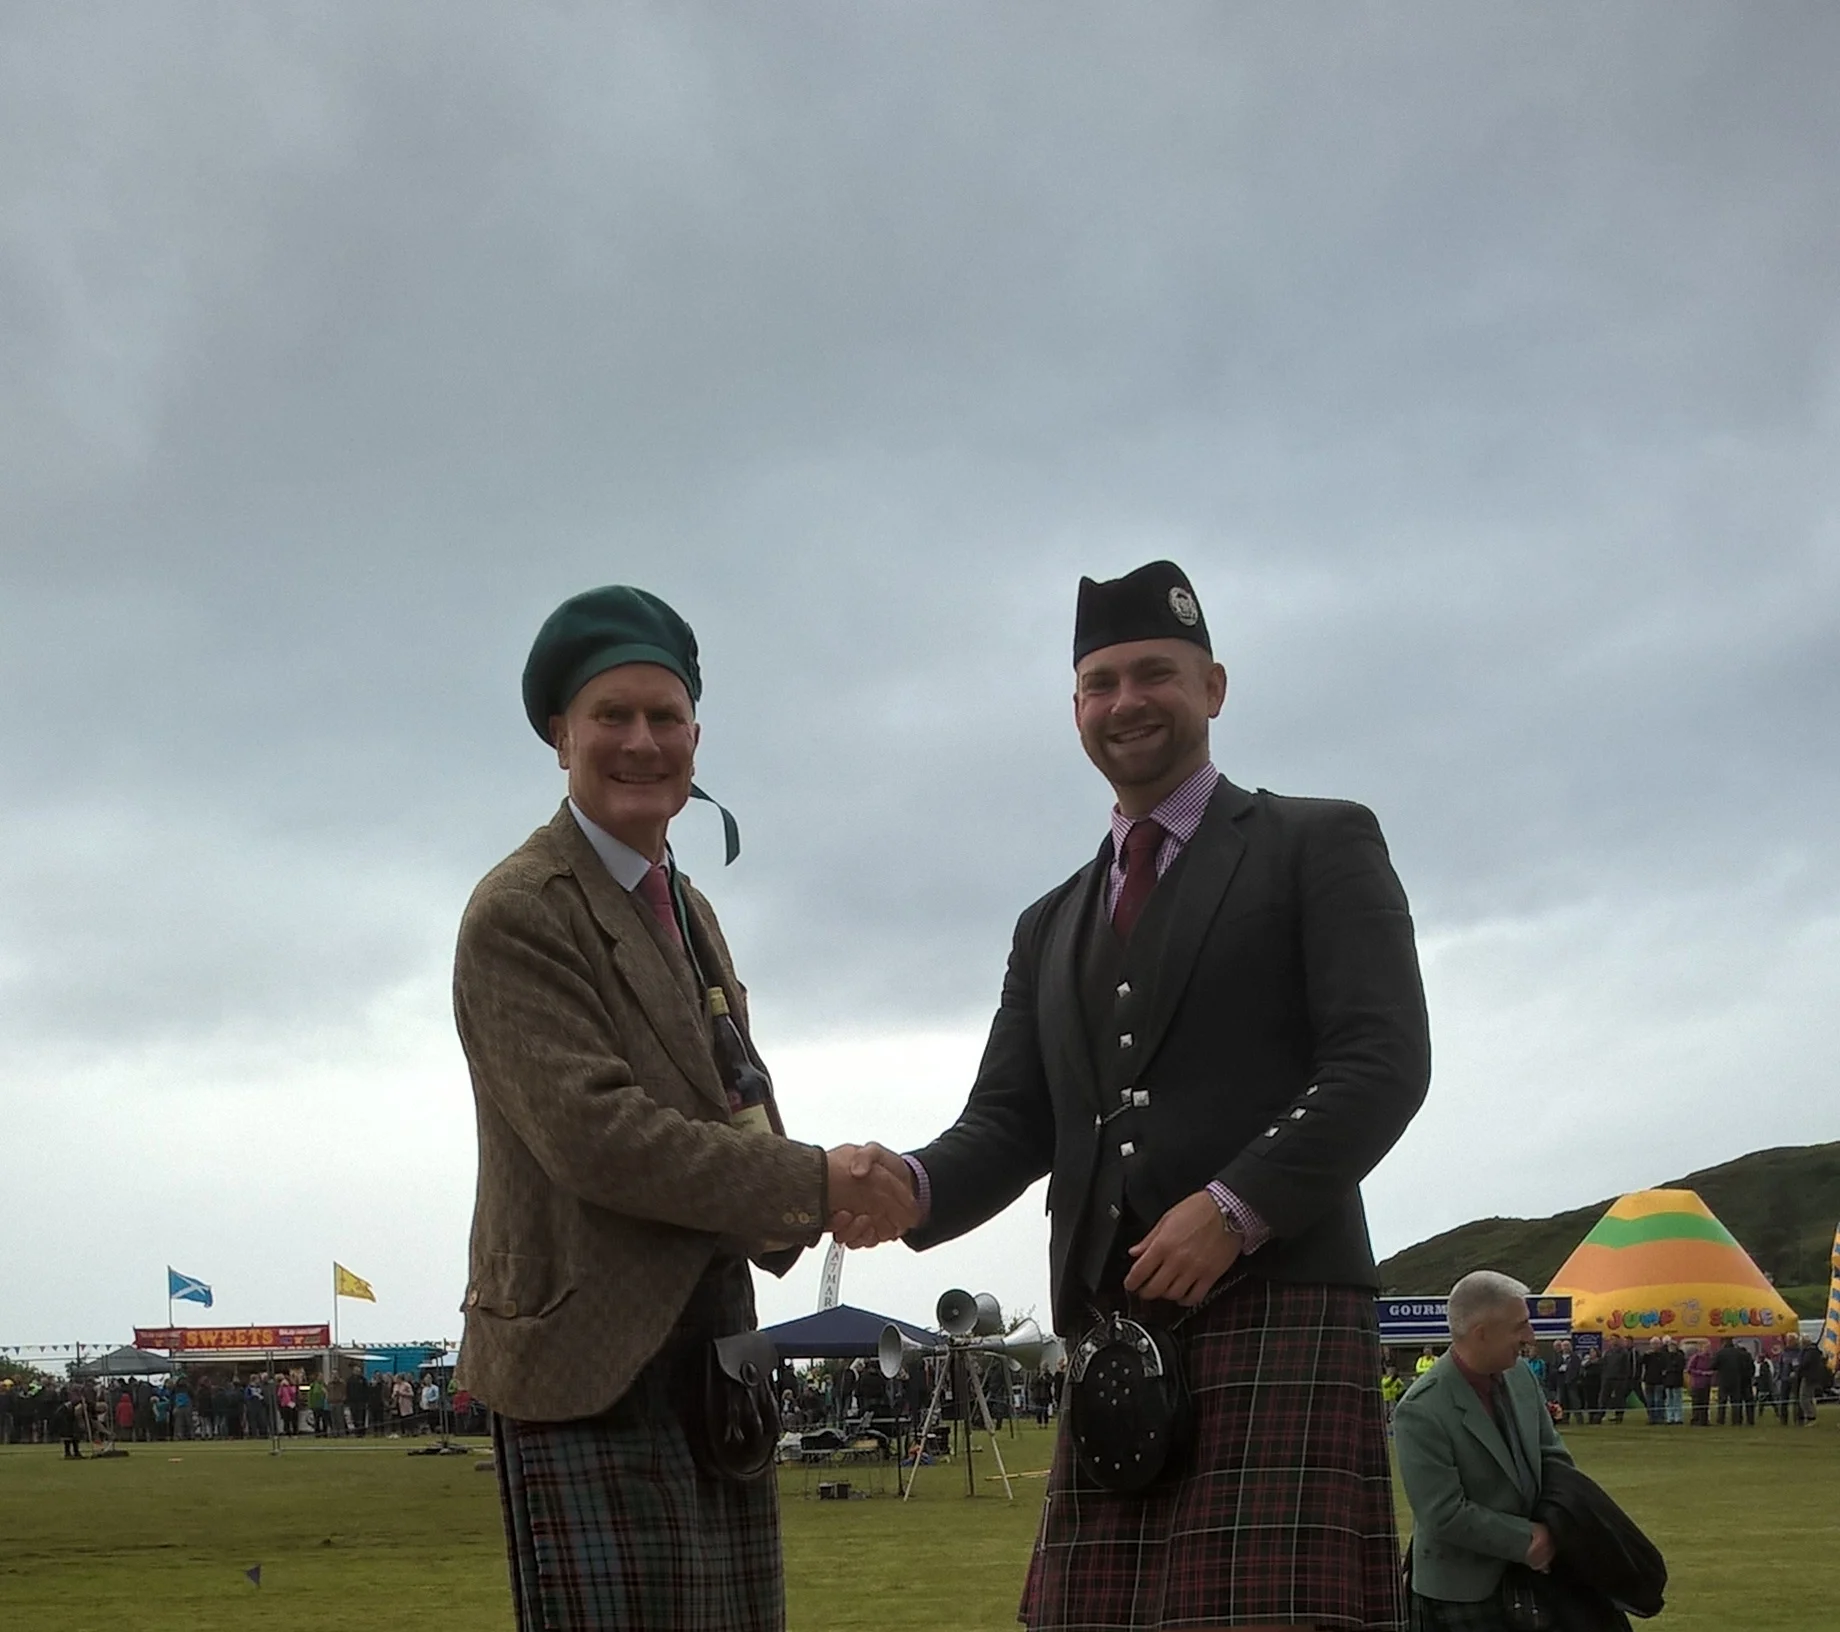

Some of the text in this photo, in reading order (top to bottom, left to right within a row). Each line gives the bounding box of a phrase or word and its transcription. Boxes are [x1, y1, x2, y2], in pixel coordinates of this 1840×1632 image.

[1606, 1309, 1676, 1330] JUMP
[1709, 1308, 1773, 1328] SMILE
[187, 1329, 274, 1346] SWEETS
